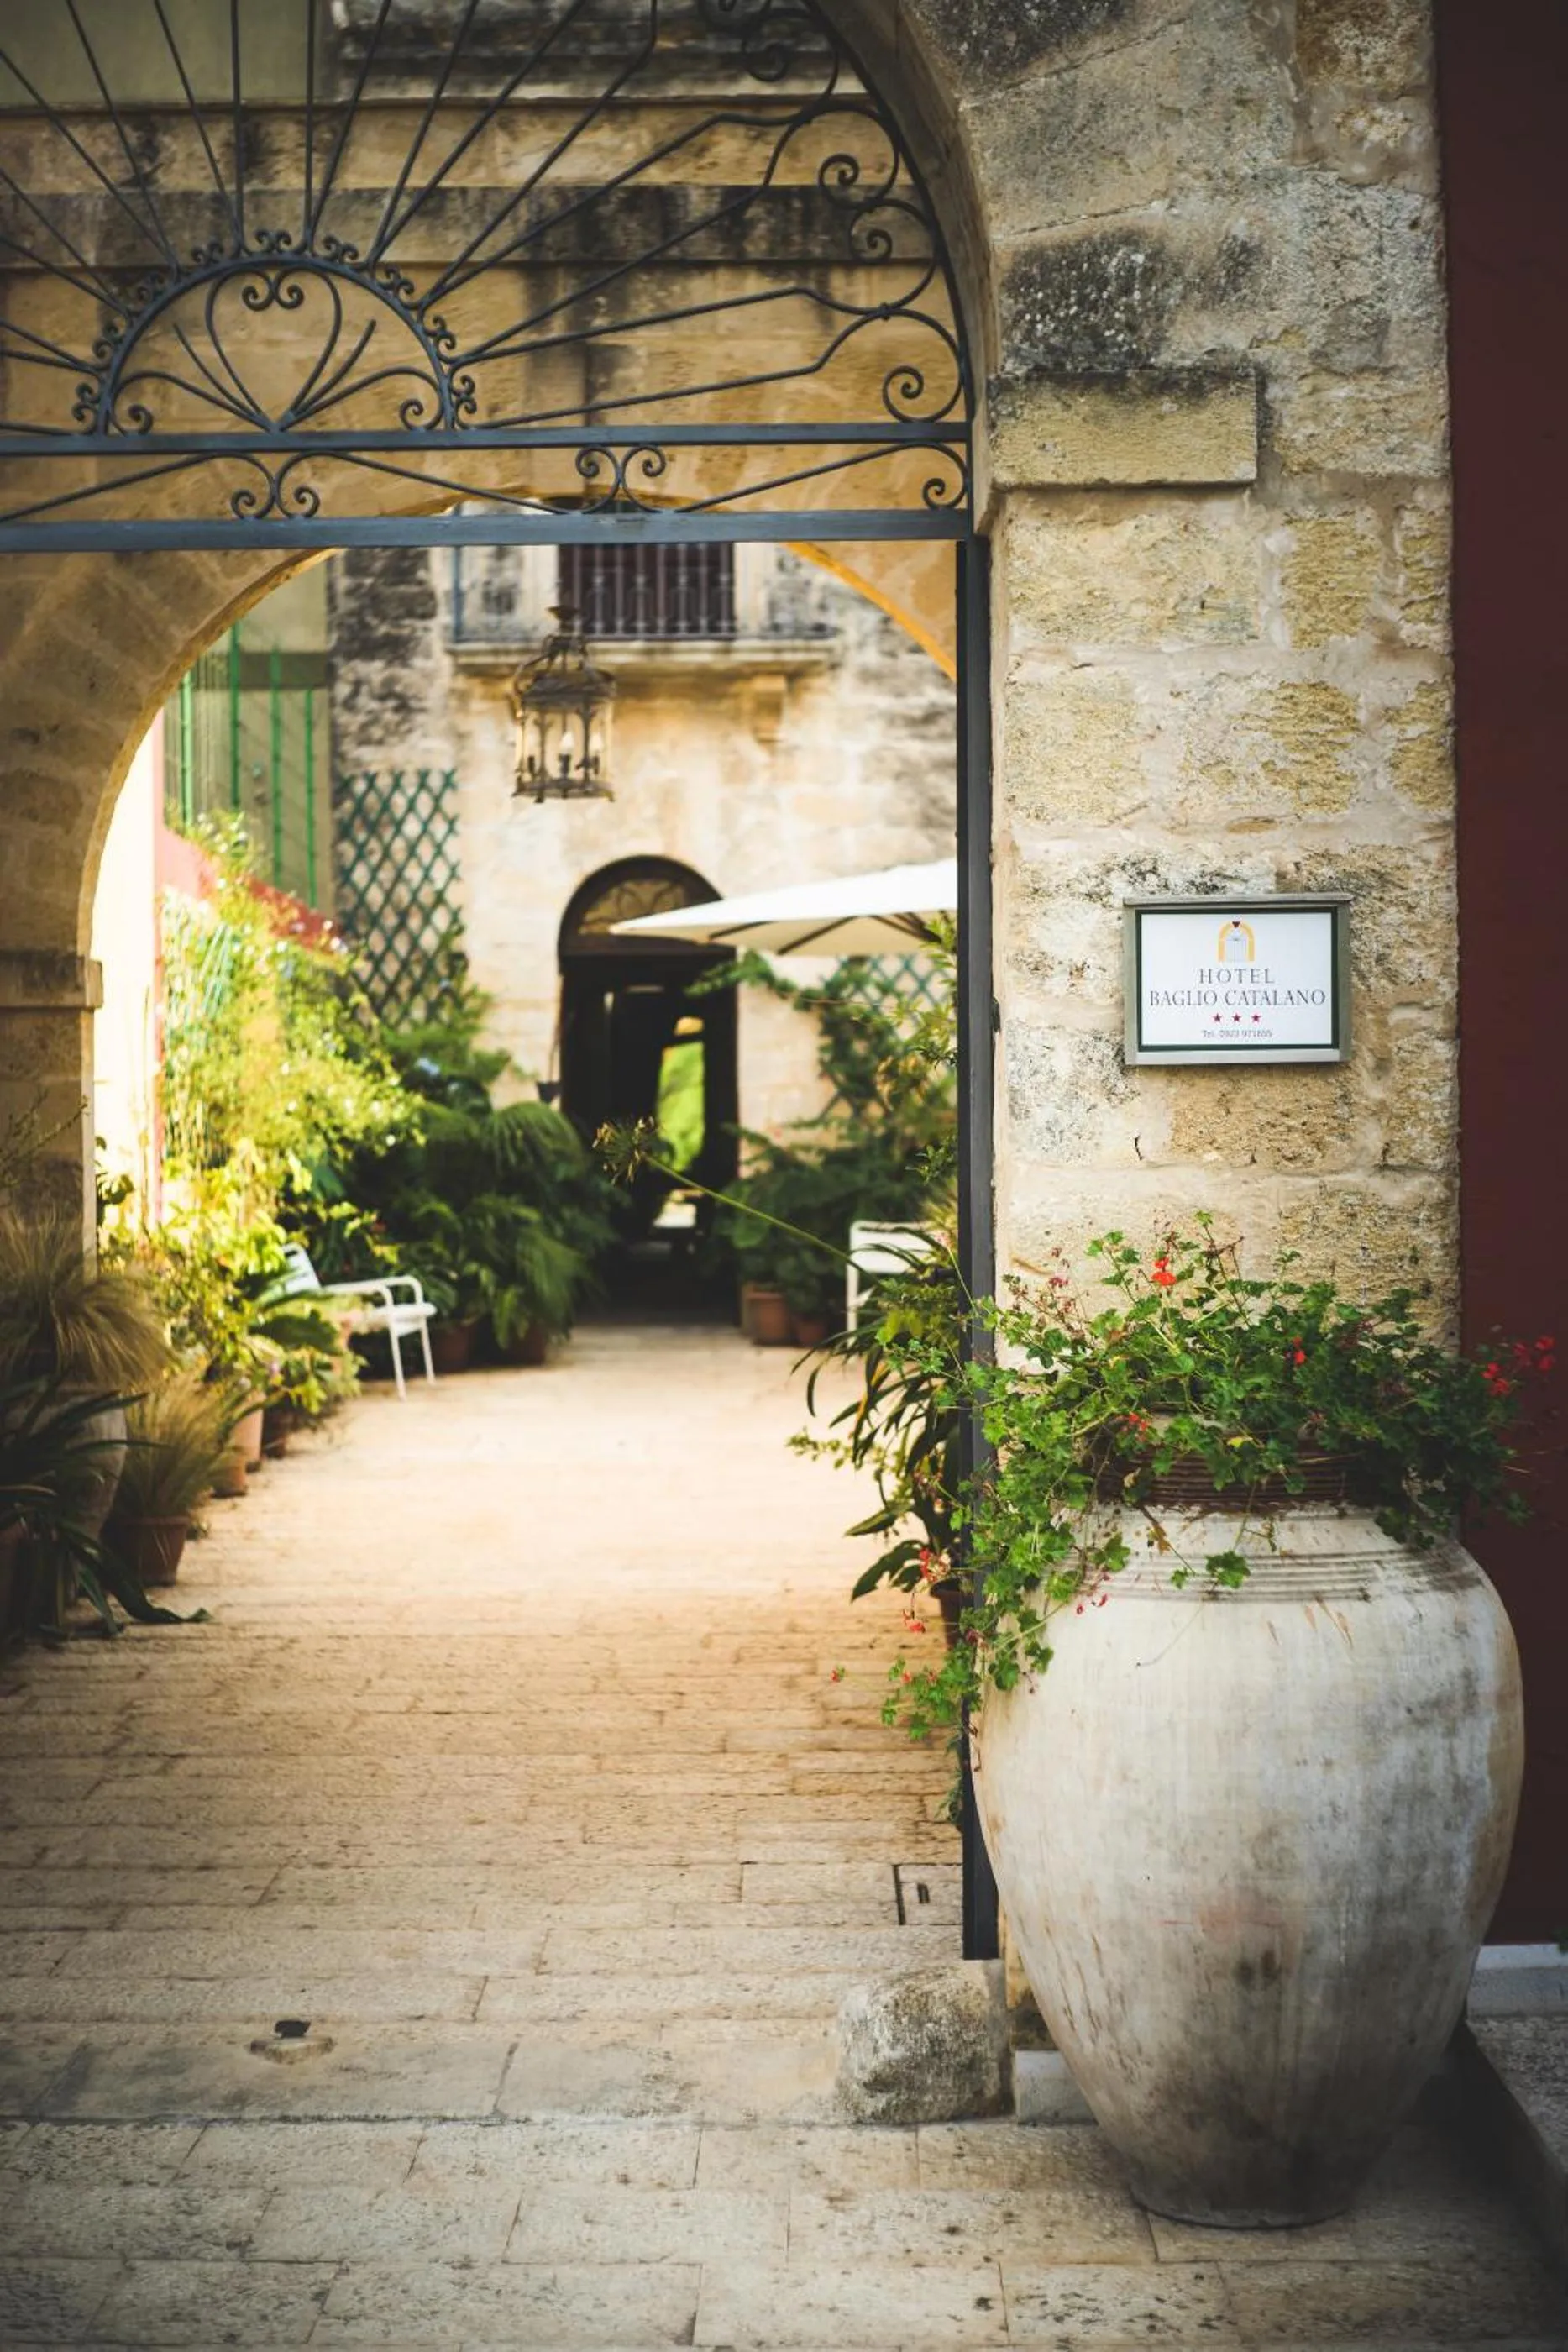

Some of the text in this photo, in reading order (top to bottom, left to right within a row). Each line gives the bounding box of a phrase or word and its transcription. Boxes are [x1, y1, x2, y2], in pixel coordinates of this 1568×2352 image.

[1199, 968, 1275, 984] HOTEL
[1150, 989, 1326, 1006] BAGLIO CATALANO
